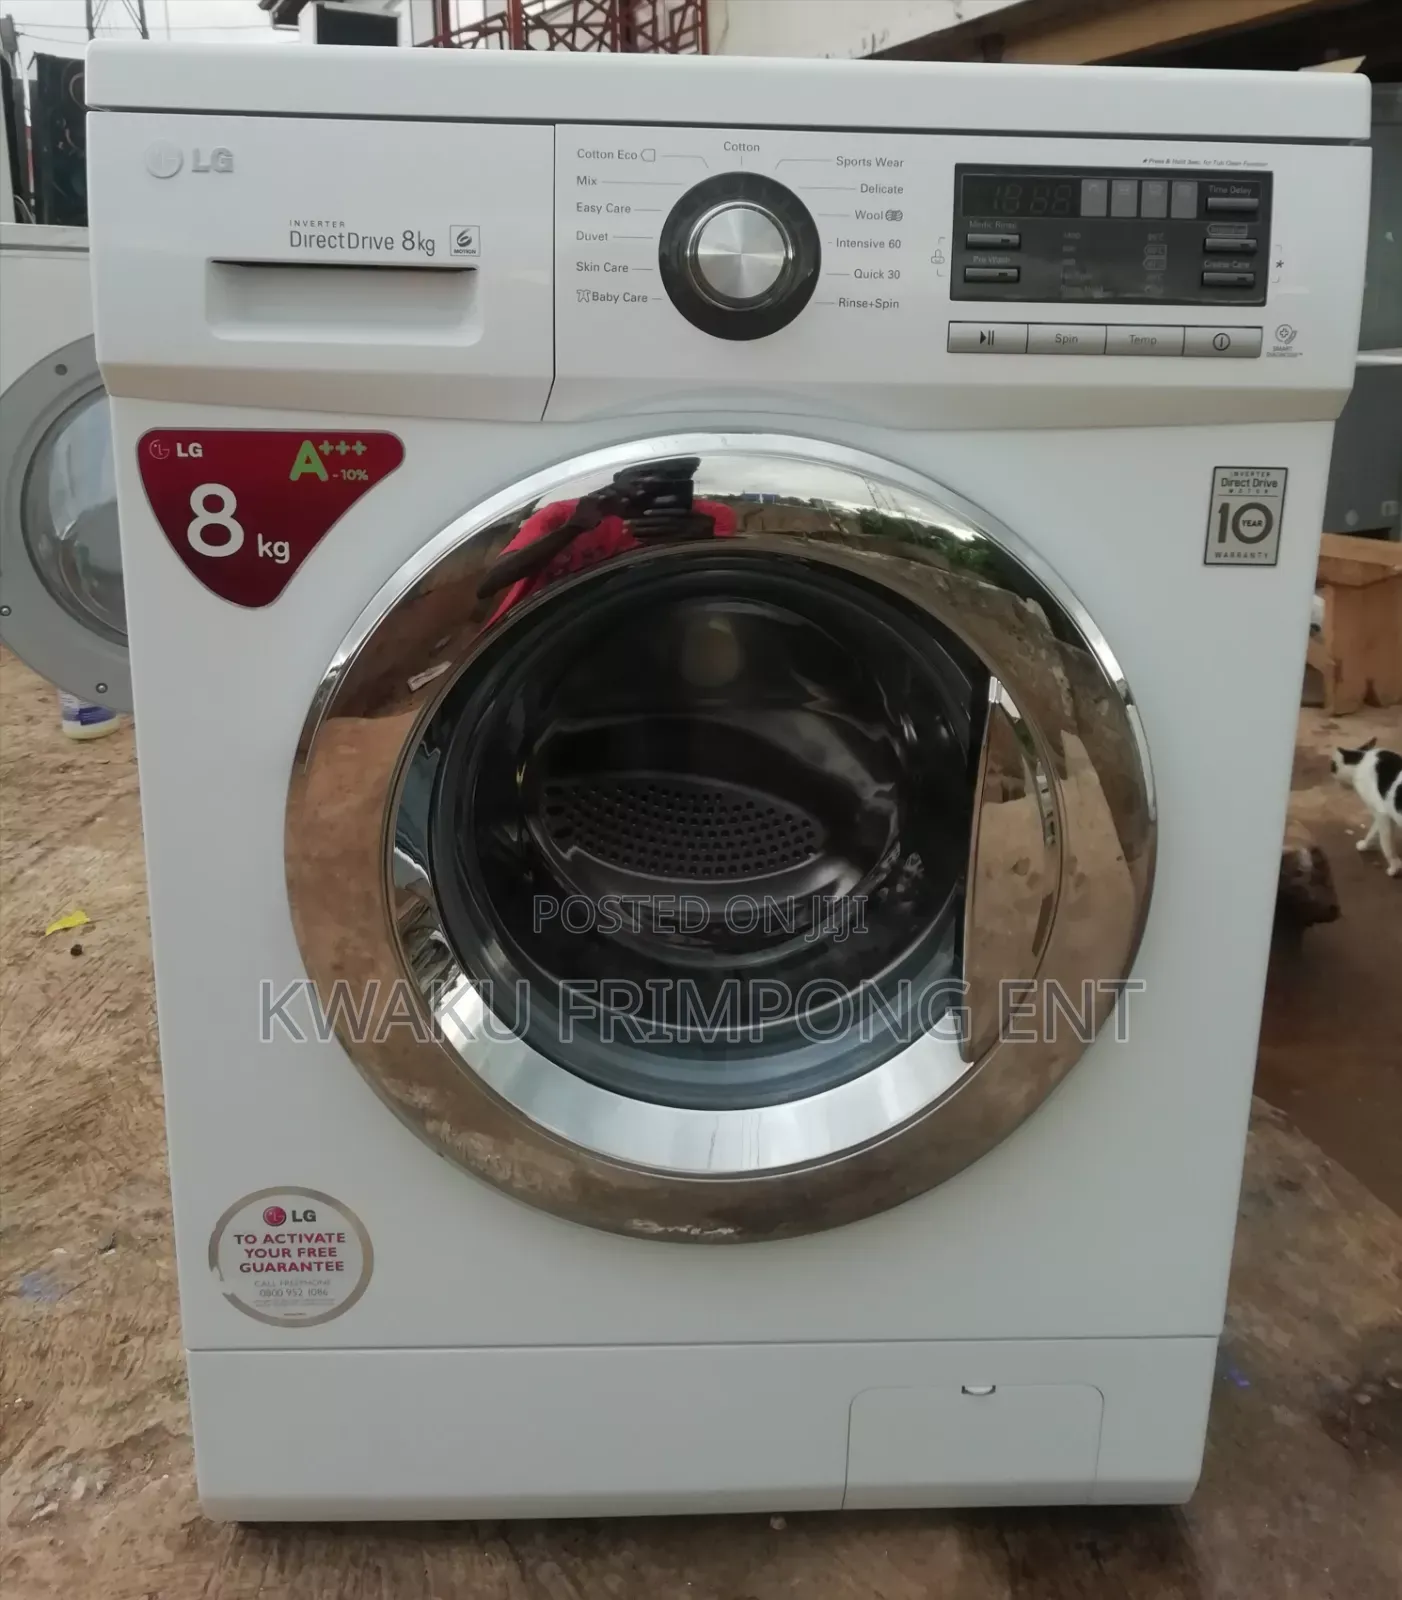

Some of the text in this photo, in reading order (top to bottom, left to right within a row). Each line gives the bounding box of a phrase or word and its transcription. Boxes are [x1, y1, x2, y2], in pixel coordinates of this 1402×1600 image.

[723, 141, 761, 153] Cotton
[191, 147, 234, 173] LG
[576, 149, 638, 161] Cotton Eco
[836, 156, 904, 169] Sports Wear
[576, 175, 598, 187] Mix
[860, 183, 904, 195] Delicate
[1209, 185, 1252, 195] Time Delay
[576, 202, 631, 216] Easy Care
[855, 210, 884, 221] Wool
[289, 220, 346, 228] INVERTER
[576, 231, 608, 242] Duvet
[401, 230, 436, 256] 8kg
[836, 238, 902, 250] Intensive 60
[576, 261, 629, 274] Skin Care
[854, 269, 900, 281] Quick 30
[592, 291, 648, 306] Baby Care
[838, 297, 900, 312] Rinse+Spin
[1055, 333, 1078, 346] Spin
[1130, 335, 1157, 348] Temp
[176, 443, 203, 458] LG
[1221, 477, 1278, 488] Direct Drive
[187, 483, 290, 564] 8 kg
[1218, 502, 1273, 544] 10
[1242, 519, 1263, 527] YEAR
[1214, 551, 1268, 559] WARRANTY
[291, 1209, 316, 1222] LG
[234, 1232, 346, 1245] TO ACTIVATE
[244, 1247, 337, 1258] YOUR FREE
[239, 1261, 344, 1273] GUARANTEE
[285, 1289, 302, 1297] 952
